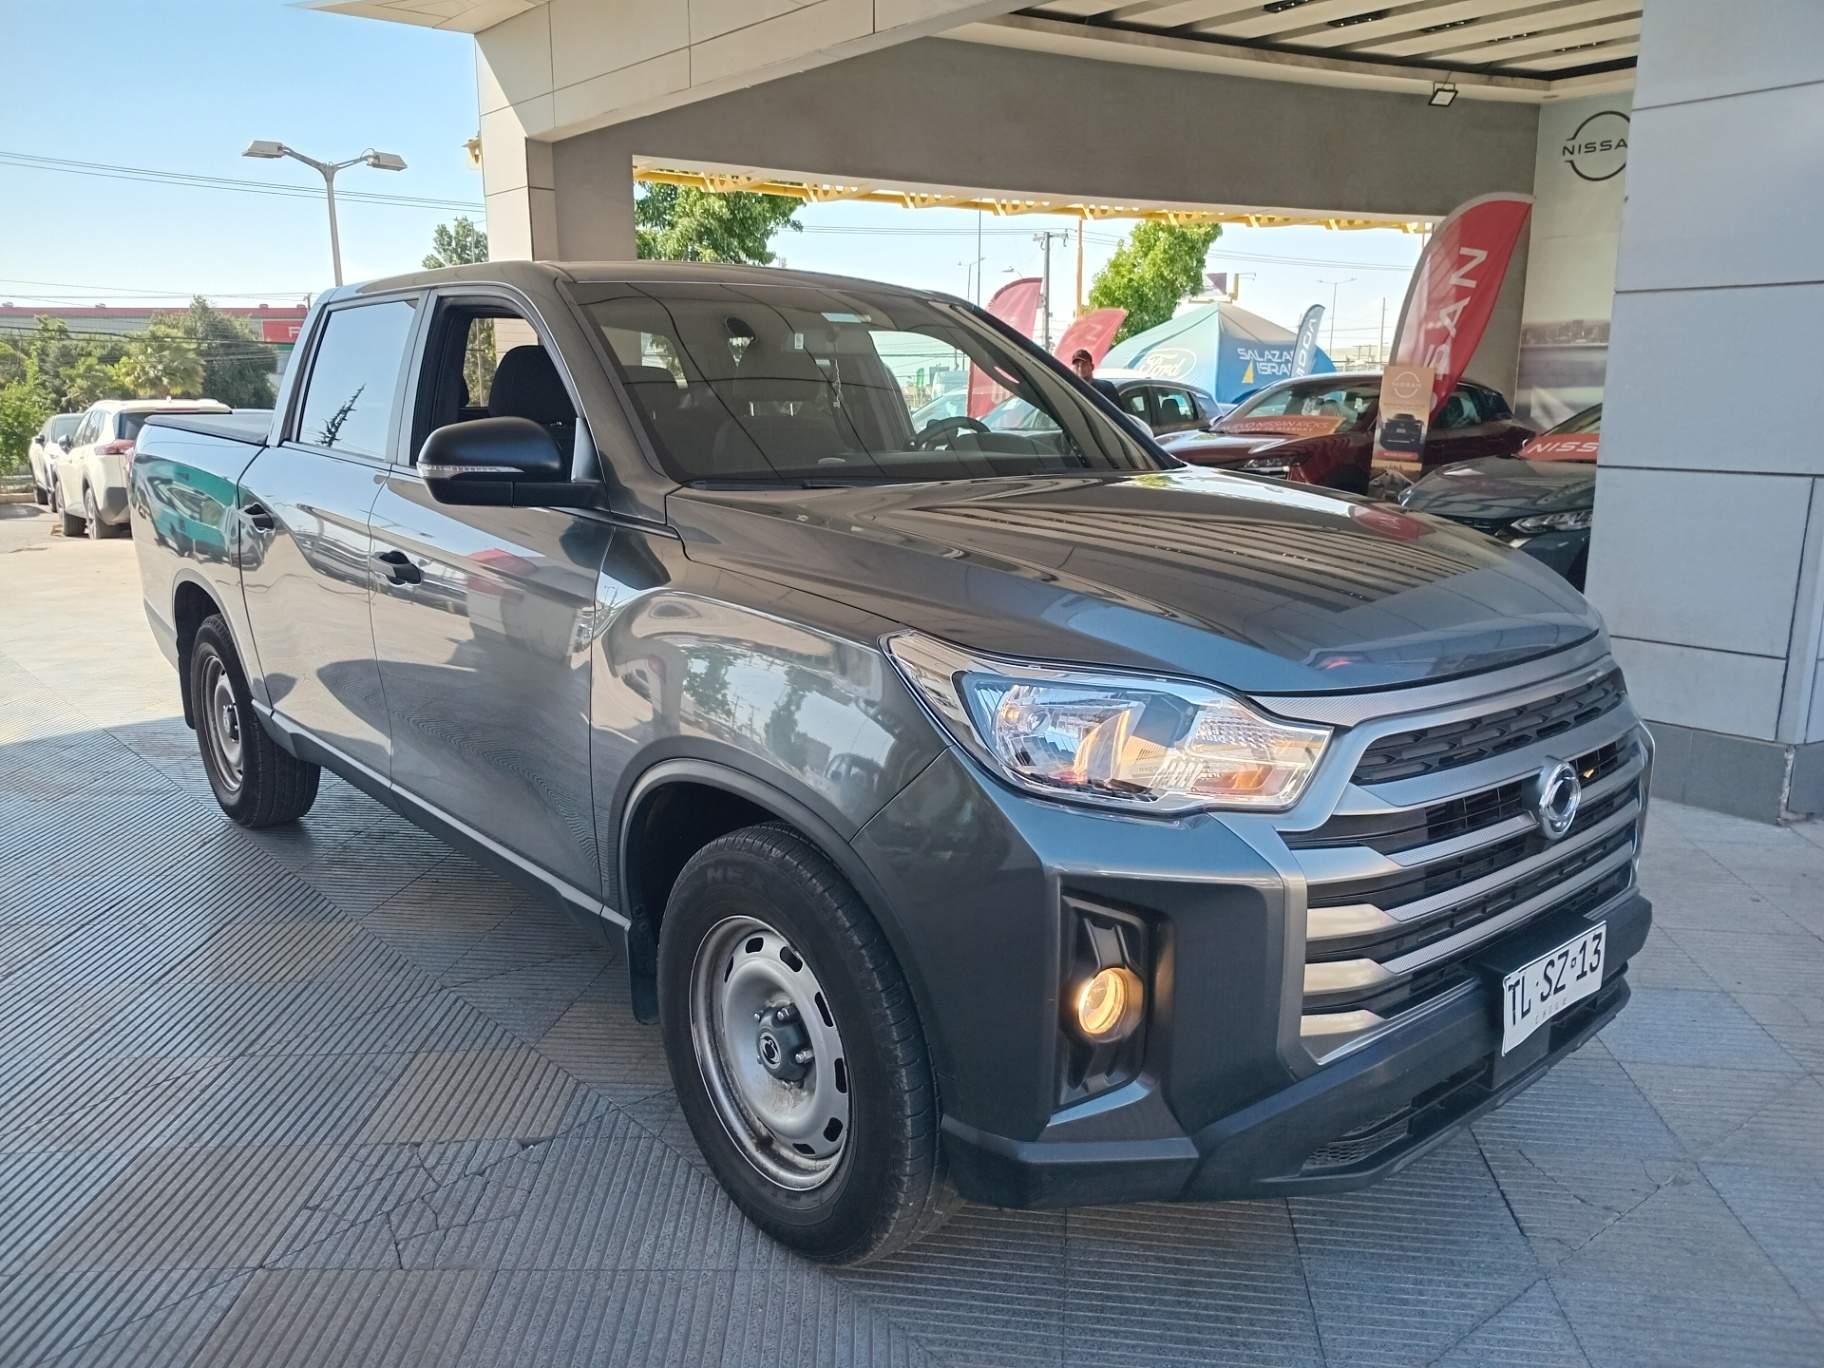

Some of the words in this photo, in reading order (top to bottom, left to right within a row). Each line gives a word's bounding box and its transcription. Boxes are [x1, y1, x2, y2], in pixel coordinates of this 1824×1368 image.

[1562, 138, 1628, 157] NISSA
[1256, 362, 1291, 377] ISRA
[1527, 441, 1600, 454] NISS
